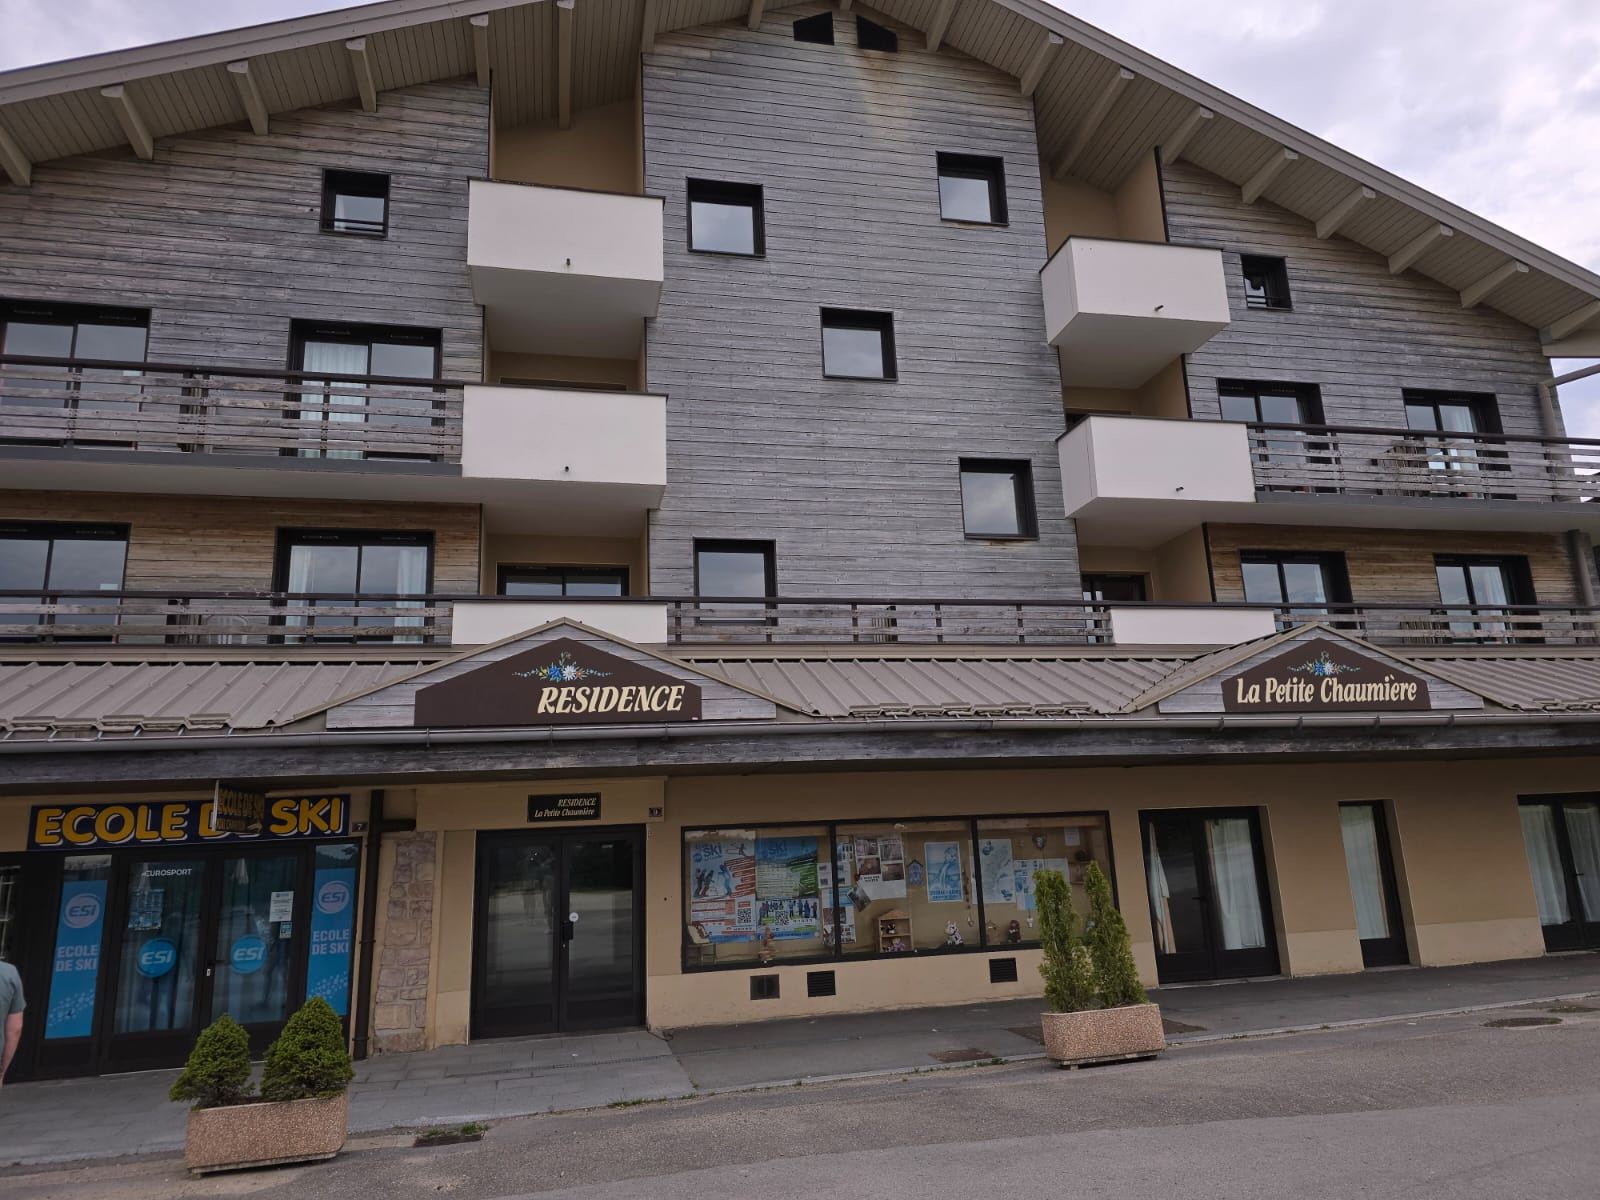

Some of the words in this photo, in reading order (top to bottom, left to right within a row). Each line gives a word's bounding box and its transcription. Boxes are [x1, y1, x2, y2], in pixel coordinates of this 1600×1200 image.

[1236, 677, 1261, 704] La
[1264, 676, 1315, 703] Petite
[1320, 674, 1418, 703] Chaumière
[537, 684, 686, 714] RESIDENCE
[557, 797, 597, 807] RESIDENCE
[534, 809, 544, 818] La
[34, 803, 190, 846] ECOLE
[269, 797, 346, 838] SKI
[145, 868, 193, 877] EUROSPORT
[312, 928, 350, 942] ECOLE
[58, 944, 98, 959] ECOLE
[311, 943, 327, 956] DE
[329, 942, 349, 955] SKI
[56, 959, 73, 972] DE
[75, 957, 97, 971] SKI
